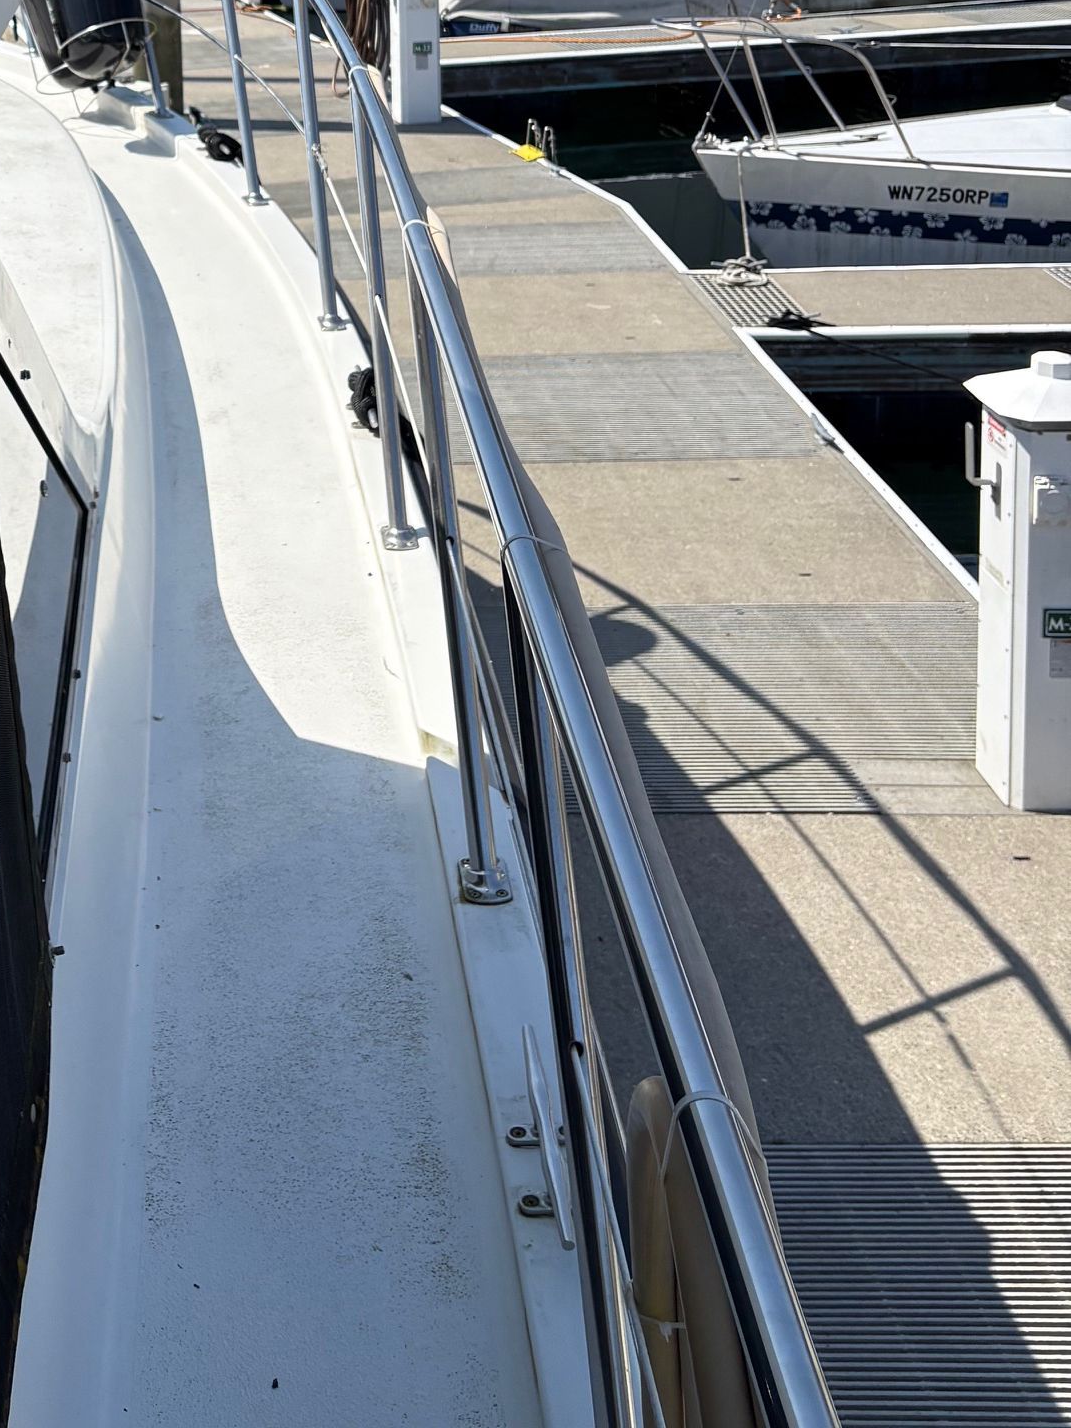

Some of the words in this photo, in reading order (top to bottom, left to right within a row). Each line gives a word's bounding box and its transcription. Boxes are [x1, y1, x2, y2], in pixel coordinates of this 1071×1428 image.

[469, 23, 499, 33] Duffy
[888, 185, 989, 204] WN7250RP
[1049, 617, 1071, 631] M-
